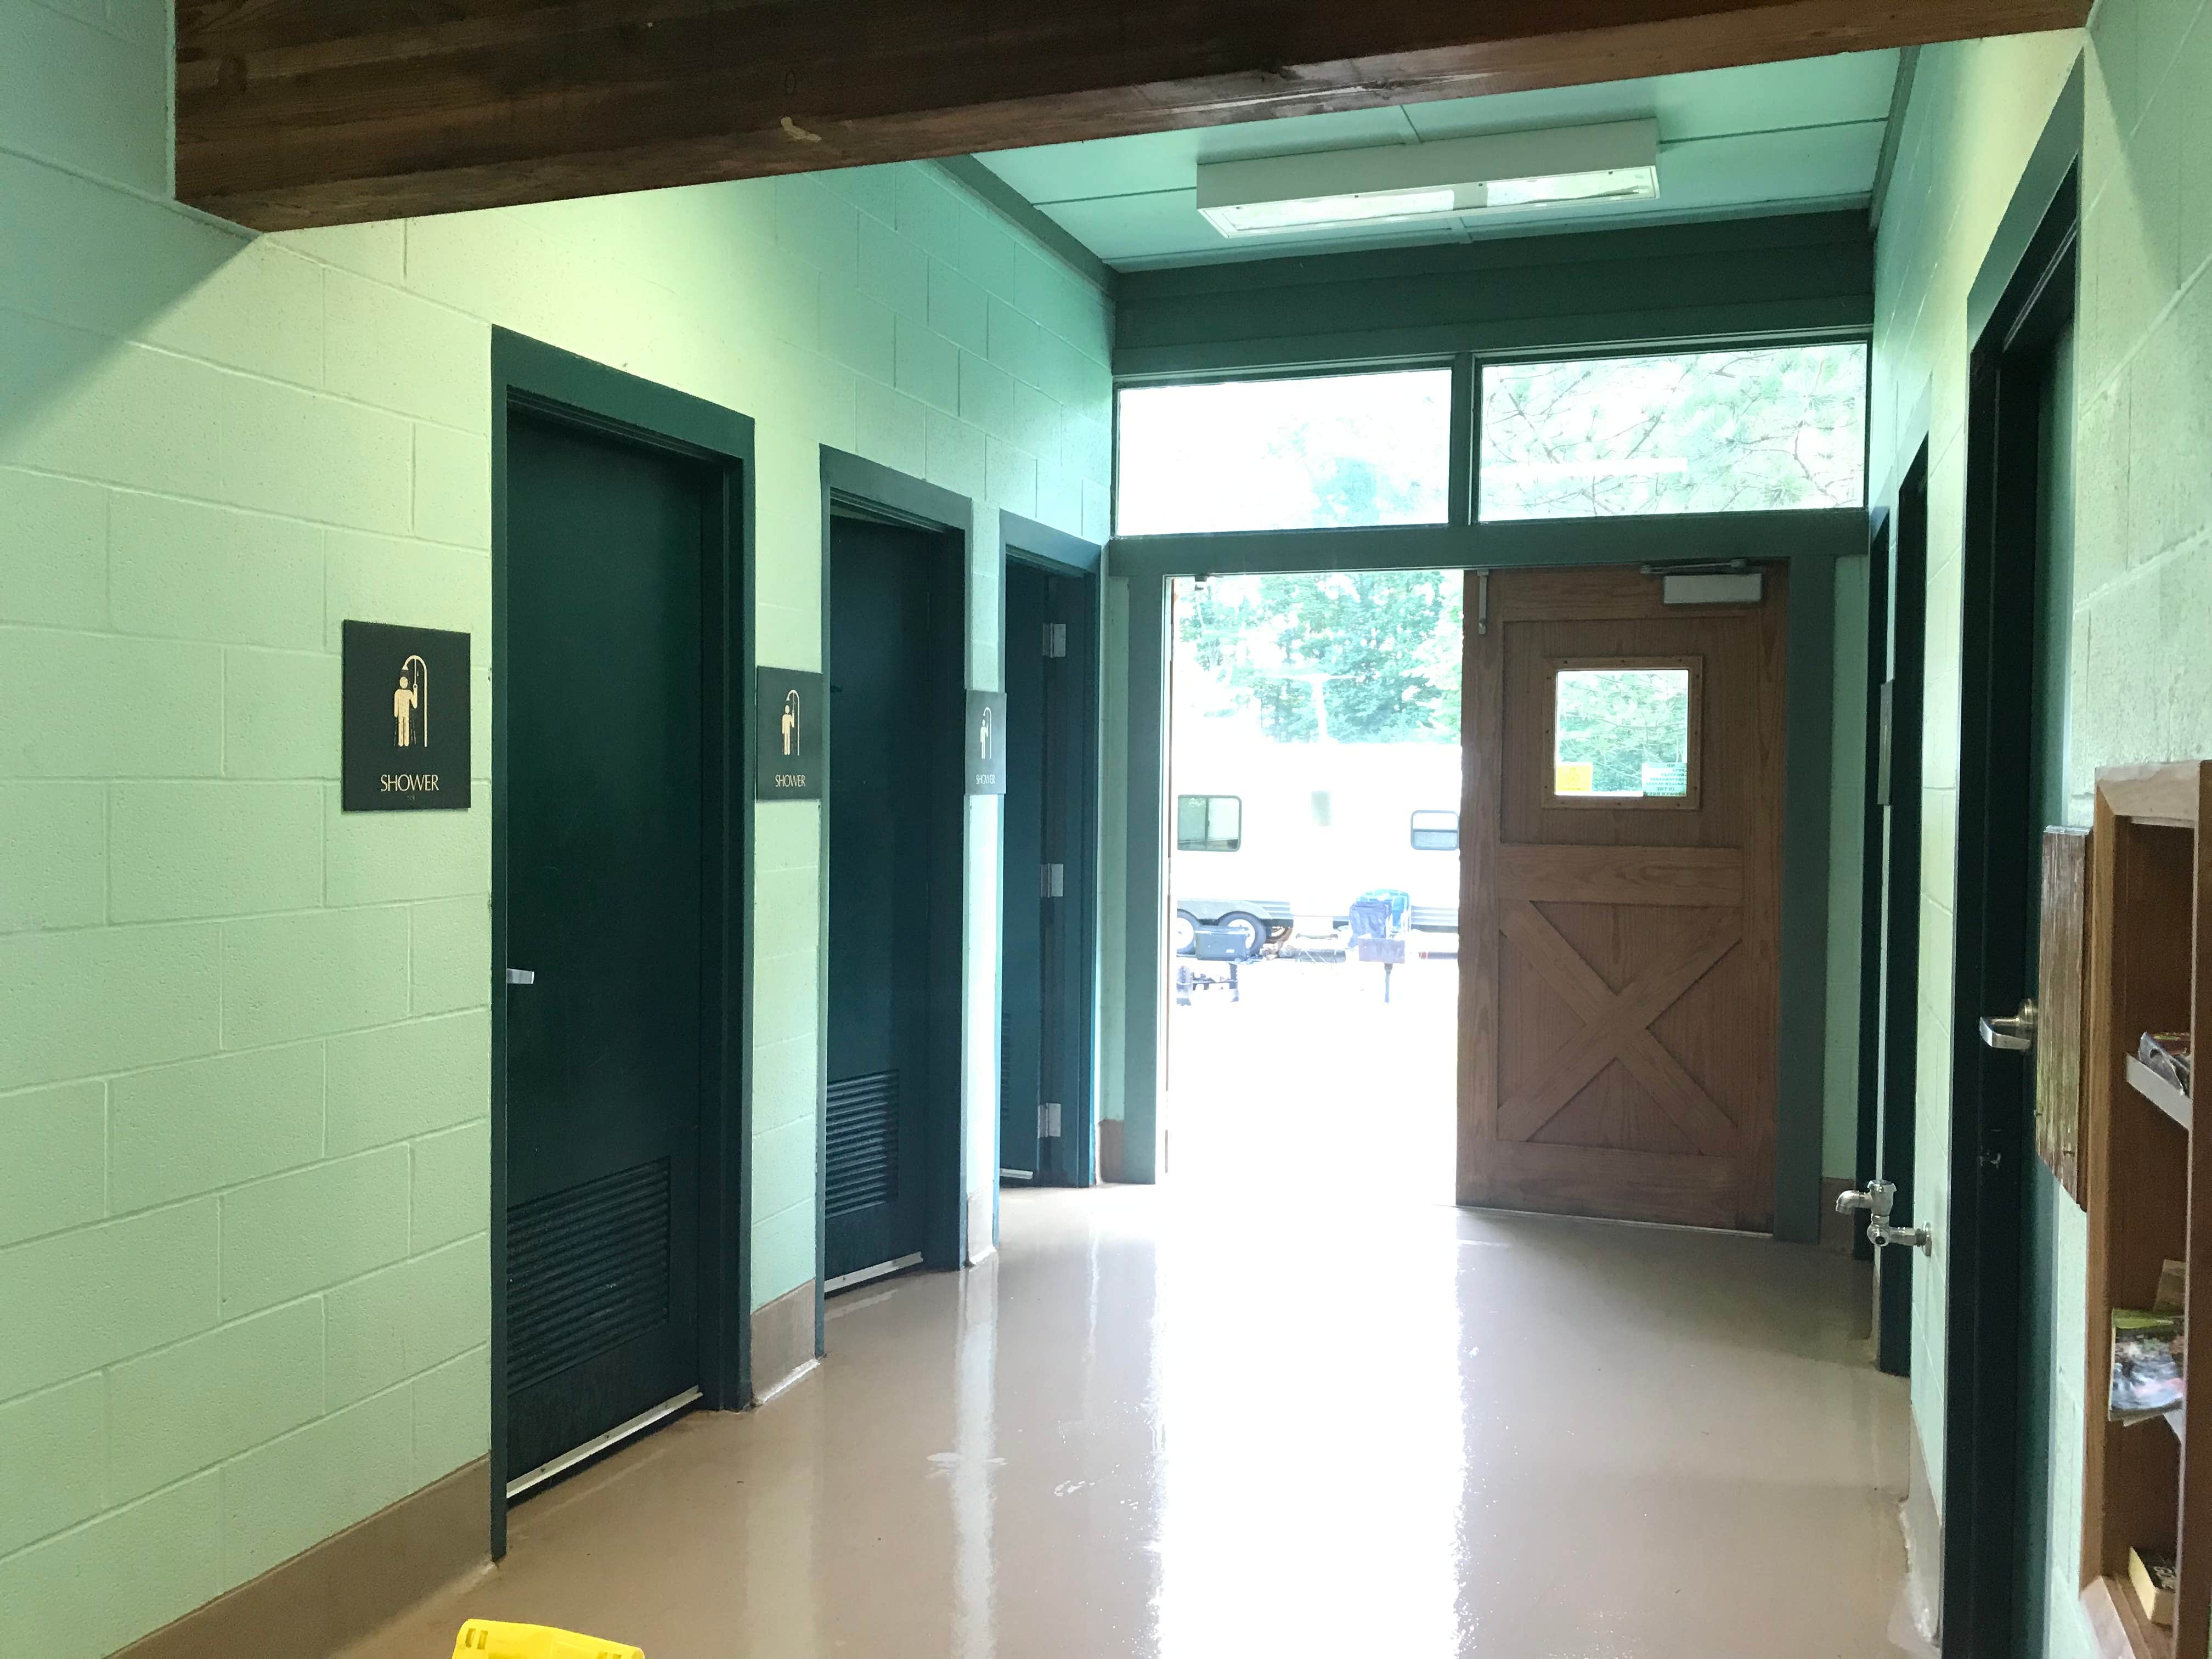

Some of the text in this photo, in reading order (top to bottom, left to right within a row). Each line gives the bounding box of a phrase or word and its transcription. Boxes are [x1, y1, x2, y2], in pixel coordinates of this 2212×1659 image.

[380, 774, 439, 792] SHOWER
[775, 774, 806, 787] SHOWER
[976, 774, 996, 785] SHOWER
